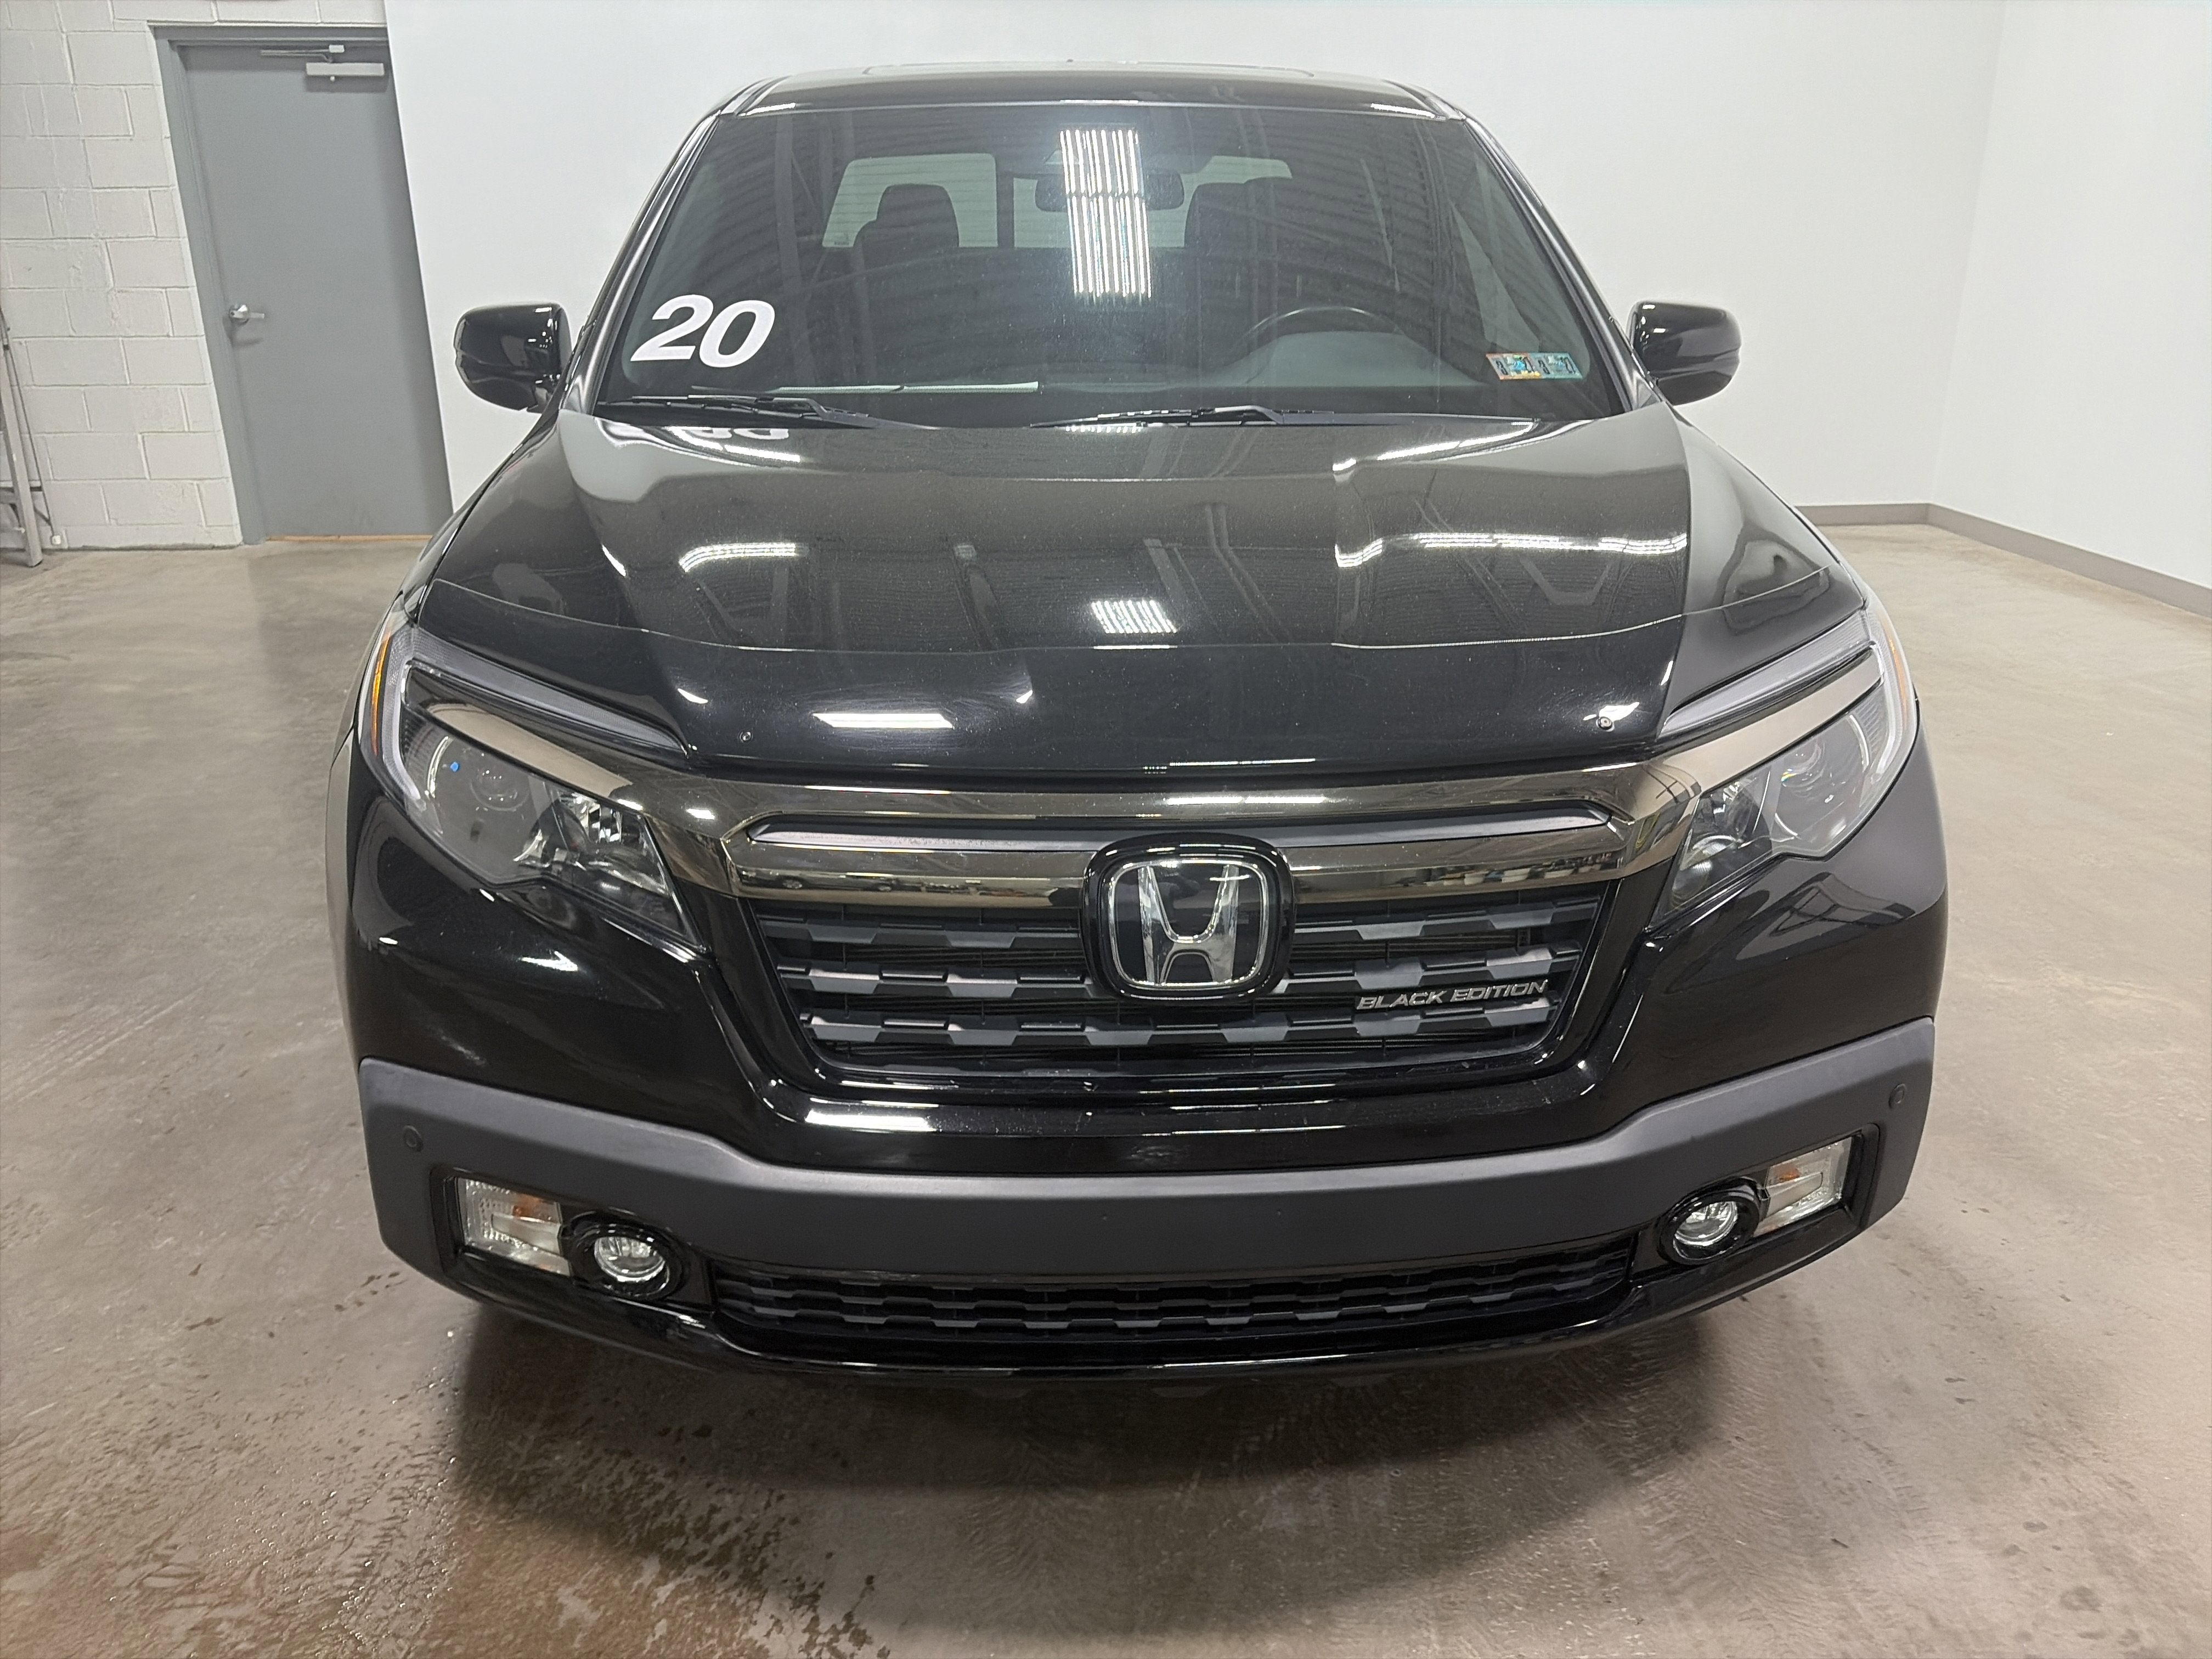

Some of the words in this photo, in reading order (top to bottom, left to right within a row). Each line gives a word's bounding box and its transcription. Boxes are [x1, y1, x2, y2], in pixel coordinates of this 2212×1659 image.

[630, 295, 775, 368] 20
[1356, 990, 1447, 1010] BLACK
[1450, 979, 1548, 1002] EDITION
